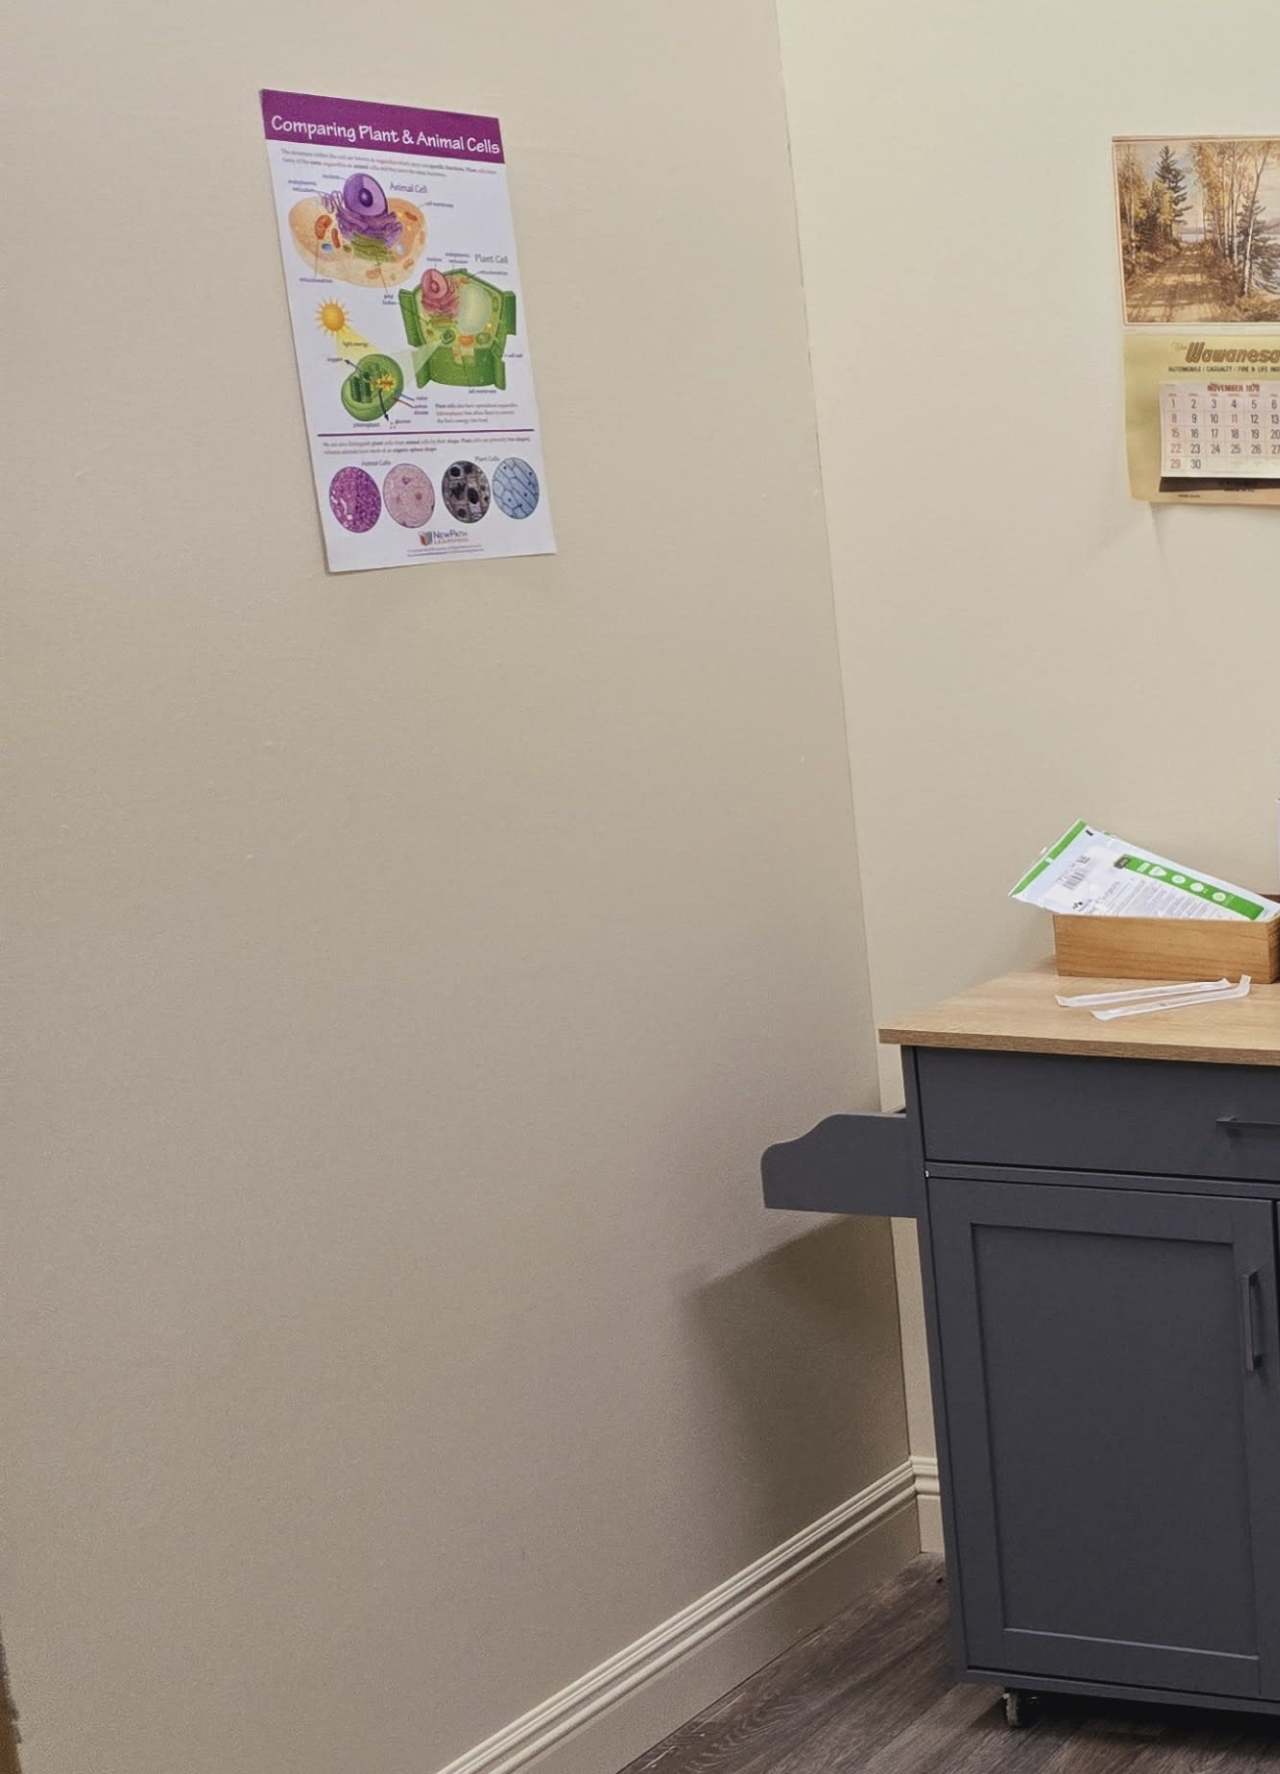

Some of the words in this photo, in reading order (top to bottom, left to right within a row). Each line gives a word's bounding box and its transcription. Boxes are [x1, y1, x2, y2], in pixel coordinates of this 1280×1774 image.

[271, 115, 356, 142] Comparing
[358, 125, 400, 143] Plant
[401, 129, 414, 145] &
[416, 131, 464, 151] Animal
[467, 137, 500, 154] Cells
[389, 181, 414, 193] Animal
[1207, 383, 1244, 393] NOVEMBER
[1171, 400, 1176, 409] 1
[1191, 400, 1196, 409] 2
[1211, 400, 1217, 409] 3
[1231, 400, 1237, 409] 4
[1251, 400, 1257, 409] 5
[1271, 400, 1277, 409] 6
[1192, 414, 1197, 424] 9
[1210, 414, 1219, 424] 10
[1250, 414, 1259, 424] 12
[1271, 414, 1279, 424] 13
[1191, 428, 1199, 439] 16
[1211, 428, 1218, 439] 17
[1231, 428, 1239, 439] 18
[1251, 428, 1259, 439] 19
[1270, 428, 1280, 439] 20
[1190, 443, 1200, 454] 23
[1211, 443, 1220, 454] 24
[1231, 443, 1241, 454] 25
[1251, 443, 1261, 454] 26
[1271, 443, 1280, 454] 27
[1191, 459, 1201, 469] 30
